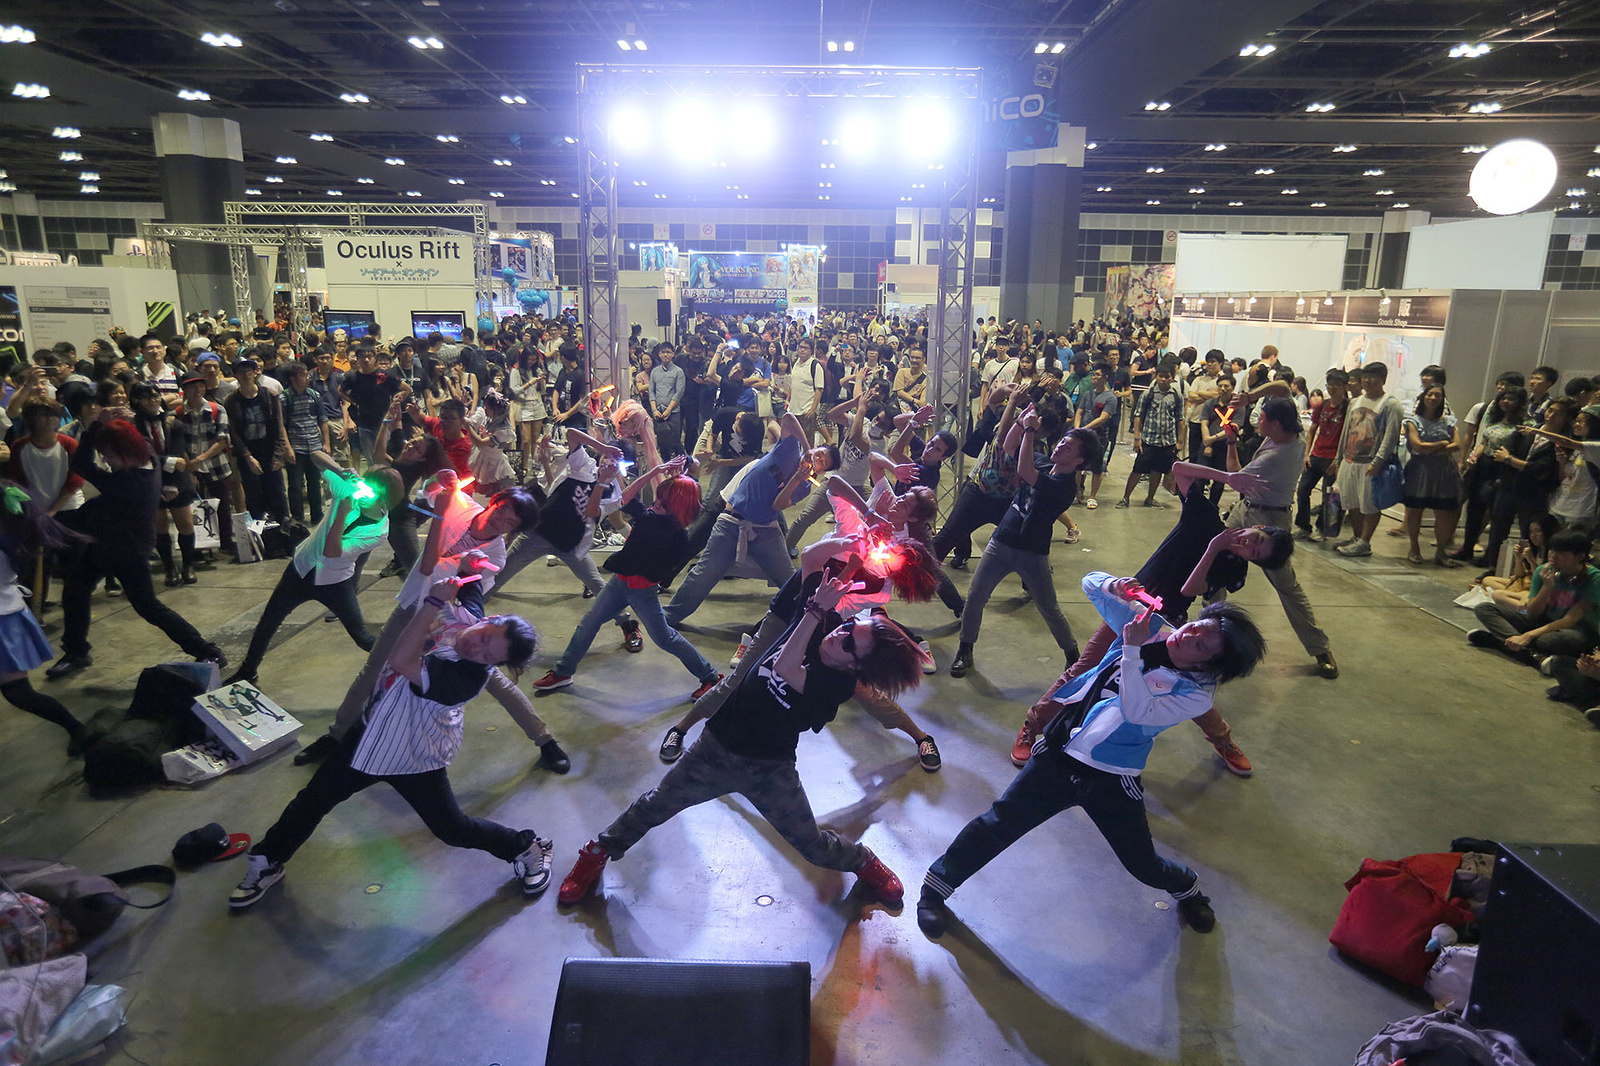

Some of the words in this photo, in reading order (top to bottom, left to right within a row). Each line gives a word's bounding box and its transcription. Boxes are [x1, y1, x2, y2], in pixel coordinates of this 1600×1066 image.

[337, 240, 414, 259] Oculus
[419, 241, 461, 259] Rift
[1377, 318, 1393, 326] Goods
[1393, 318, 1408, 328] Shop
